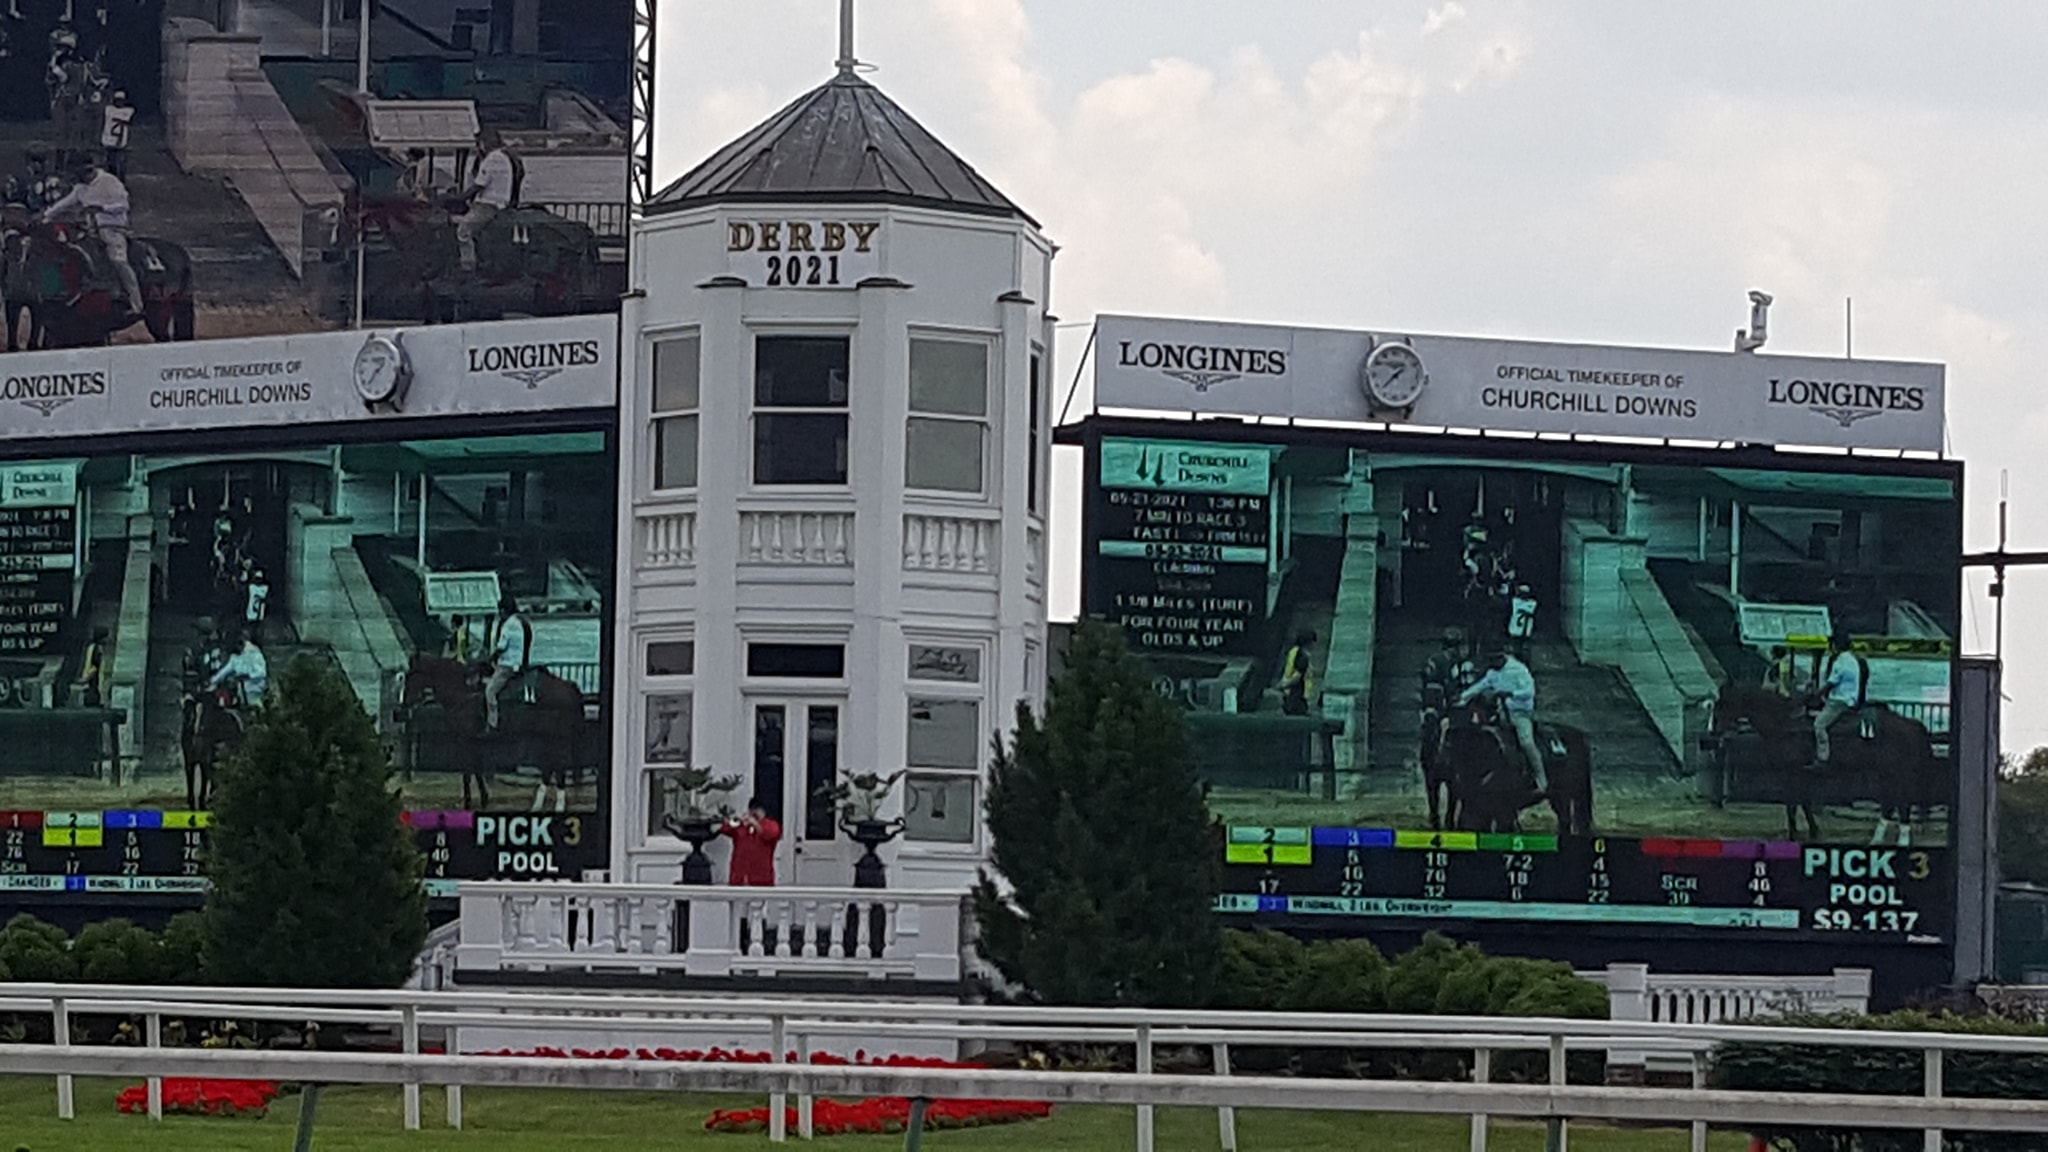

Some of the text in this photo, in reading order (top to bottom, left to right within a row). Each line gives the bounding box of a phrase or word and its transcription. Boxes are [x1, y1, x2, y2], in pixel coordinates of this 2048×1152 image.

[728, 222, 880, 251] DERBY
[767, 256, 839, 286] 2021
[469, 340, 599, 372] LONGINES
[1119, 341, 1286, 375] LONGINES
[161, 361, 302, 382] OFFICIAL TIMEKEEPER OF
[1497, 365, 1684, 389] OFFICIAL TIMEKEEPER OF
[150, 383, 311, 409] CHURCHILL DOWNS
[1482, 387, 1697, 418] CHURCHILL DOWNS
[1767, 379, 1924, 411] LONGINES
[12, 813, 19, 828] 1
[69, 813, 78, 828] 2
[128, 814, 137, 828] 3
[476, 816, 581, 846] PICK 3
[6, 830, 24, 844] 22
[69, 829, 76, 846] 1
[1263, 828, 1276, 844] 2
[1348, 830, 1360, 846] 3
[1430, 834, 1442, 848] 4
[66, 861, 80, 875] 17
[122, 862, 139, 875] 22
[498, 852, 559, 873] POOL
[1263, 846, 1274, 864] 1
[1593, 856, 1605, 871] 4
[1804, 848, 1930, 879] PICK 3
[1259, 880, 1279, 894] 17
[1341, 882, 1363, 896] 22
[1753, 894, 1765, 906] 4
[1830, 884, 1903, 905] POOL
